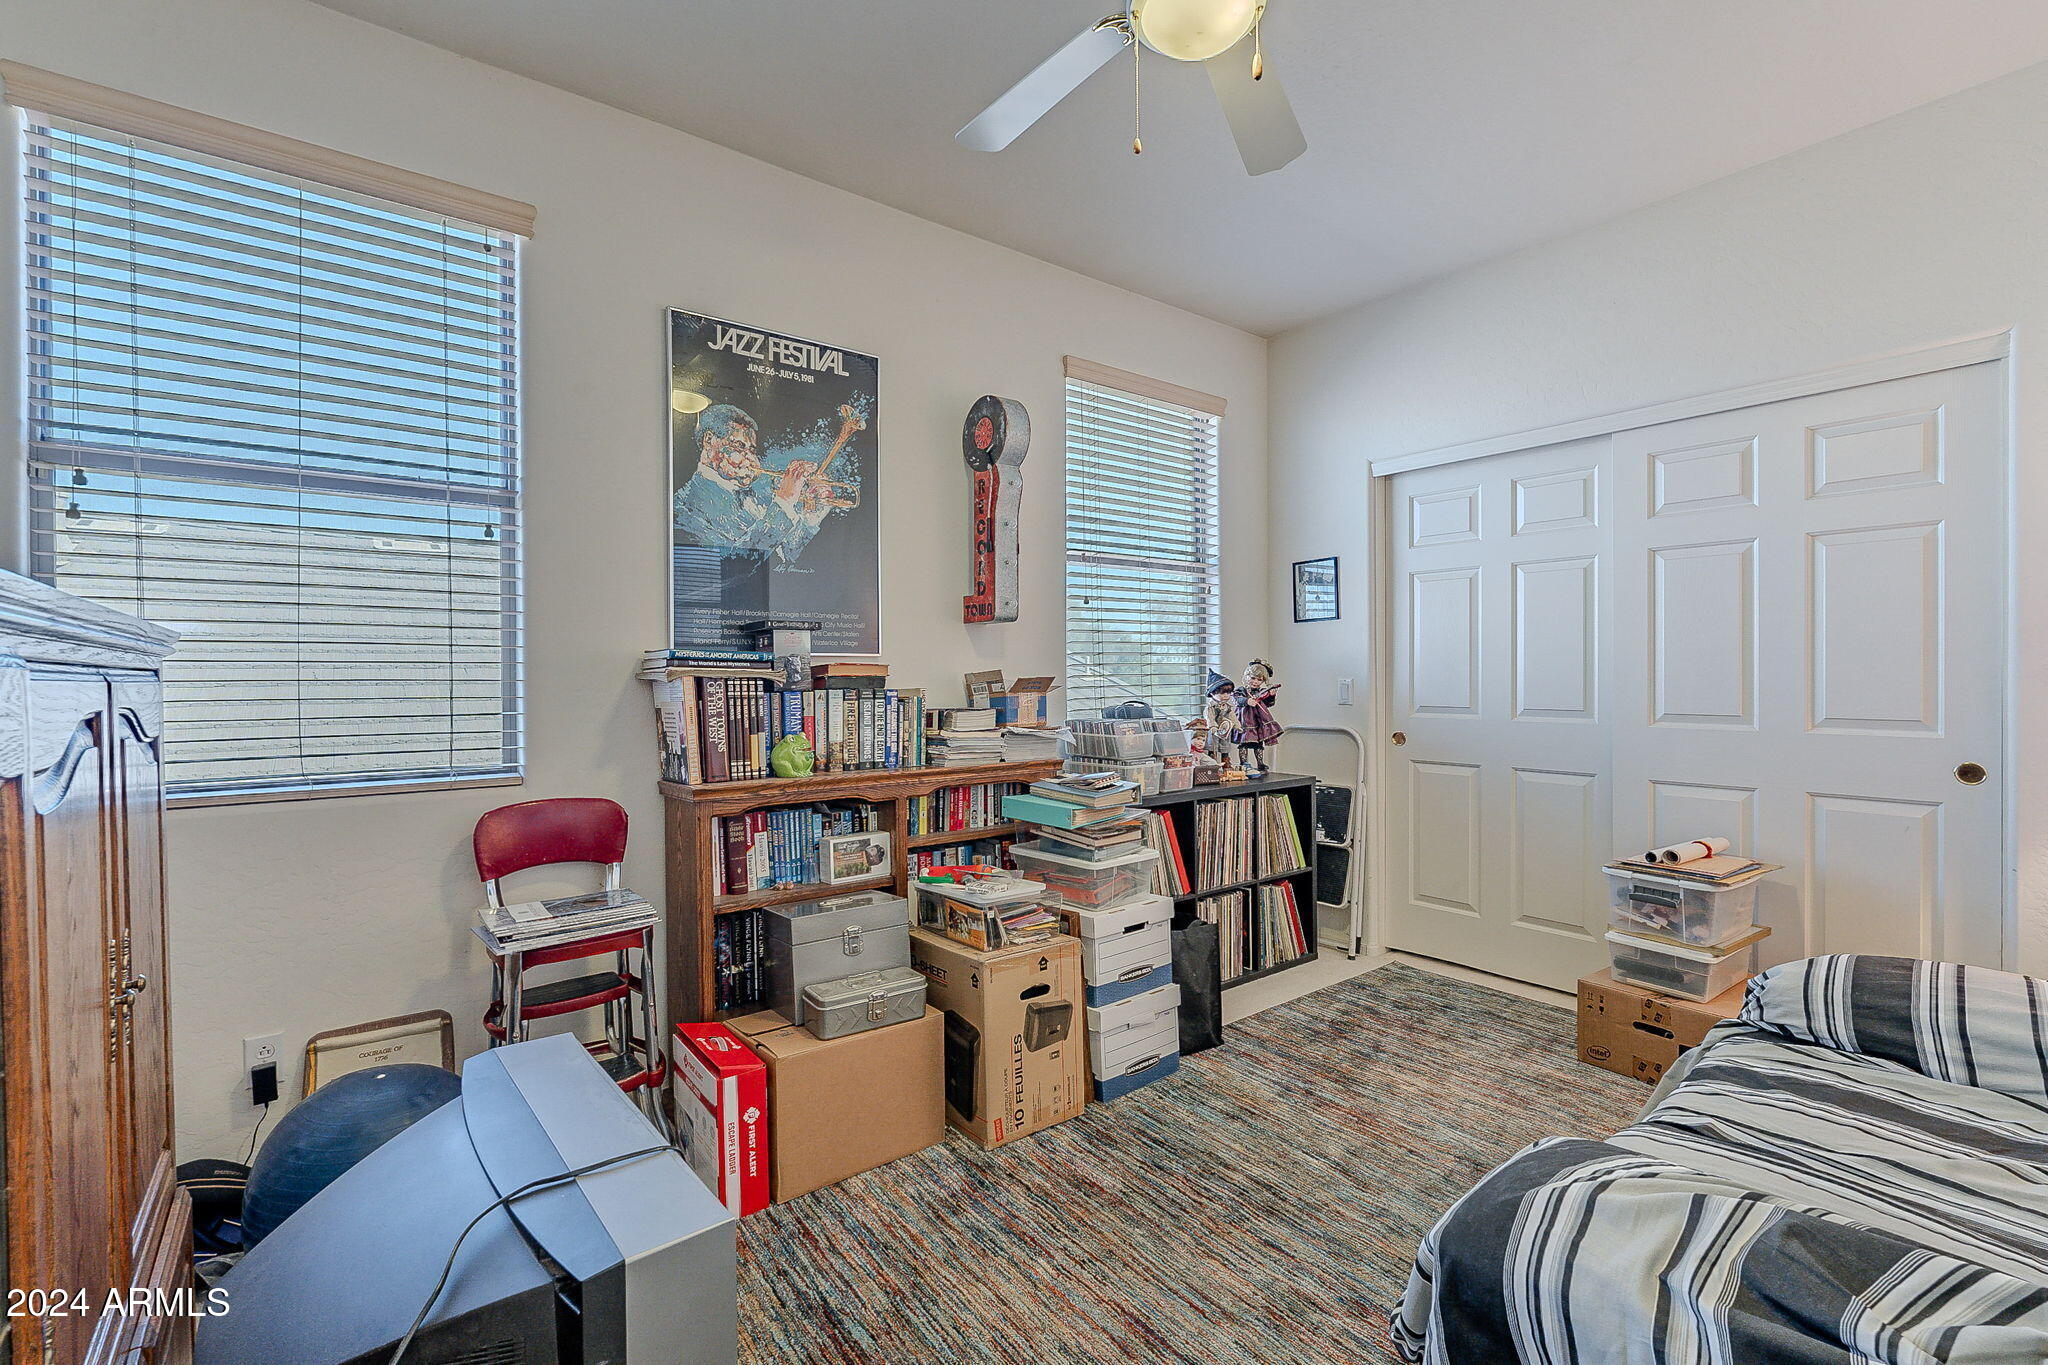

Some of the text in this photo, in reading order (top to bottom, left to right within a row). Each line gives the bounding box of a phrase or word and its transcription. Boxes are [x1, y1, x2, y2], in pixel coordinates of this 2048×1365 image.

[707, 324, 850, 376] JAZZ FESTIVAL
[746, 363, 766, 375] JUNE
[765, 367, 775, 376] 26
[778, 369, 794, 379] JULY
[801, 373, 815, 384] 1981
[964, 602, 993, 617] TOWN
[706, 681, 718, 744] OF THE WEST
[715, 681, 727, 753] GHOST TOWNS
[790, 694, 802, 732] TRUMAN
[847, 702, 856, 718] FIRE
[864, 701, 872, 760] ISLAND INFERNOS
[877, 740, 885, 760] EARTH
[1013, 1033, 1025, 1130] 10 FEUILLES
[727, 1121, 736, 1176] ESCAPE LADDER
[748, 1124, 757, 1177] FIRST ALERT
